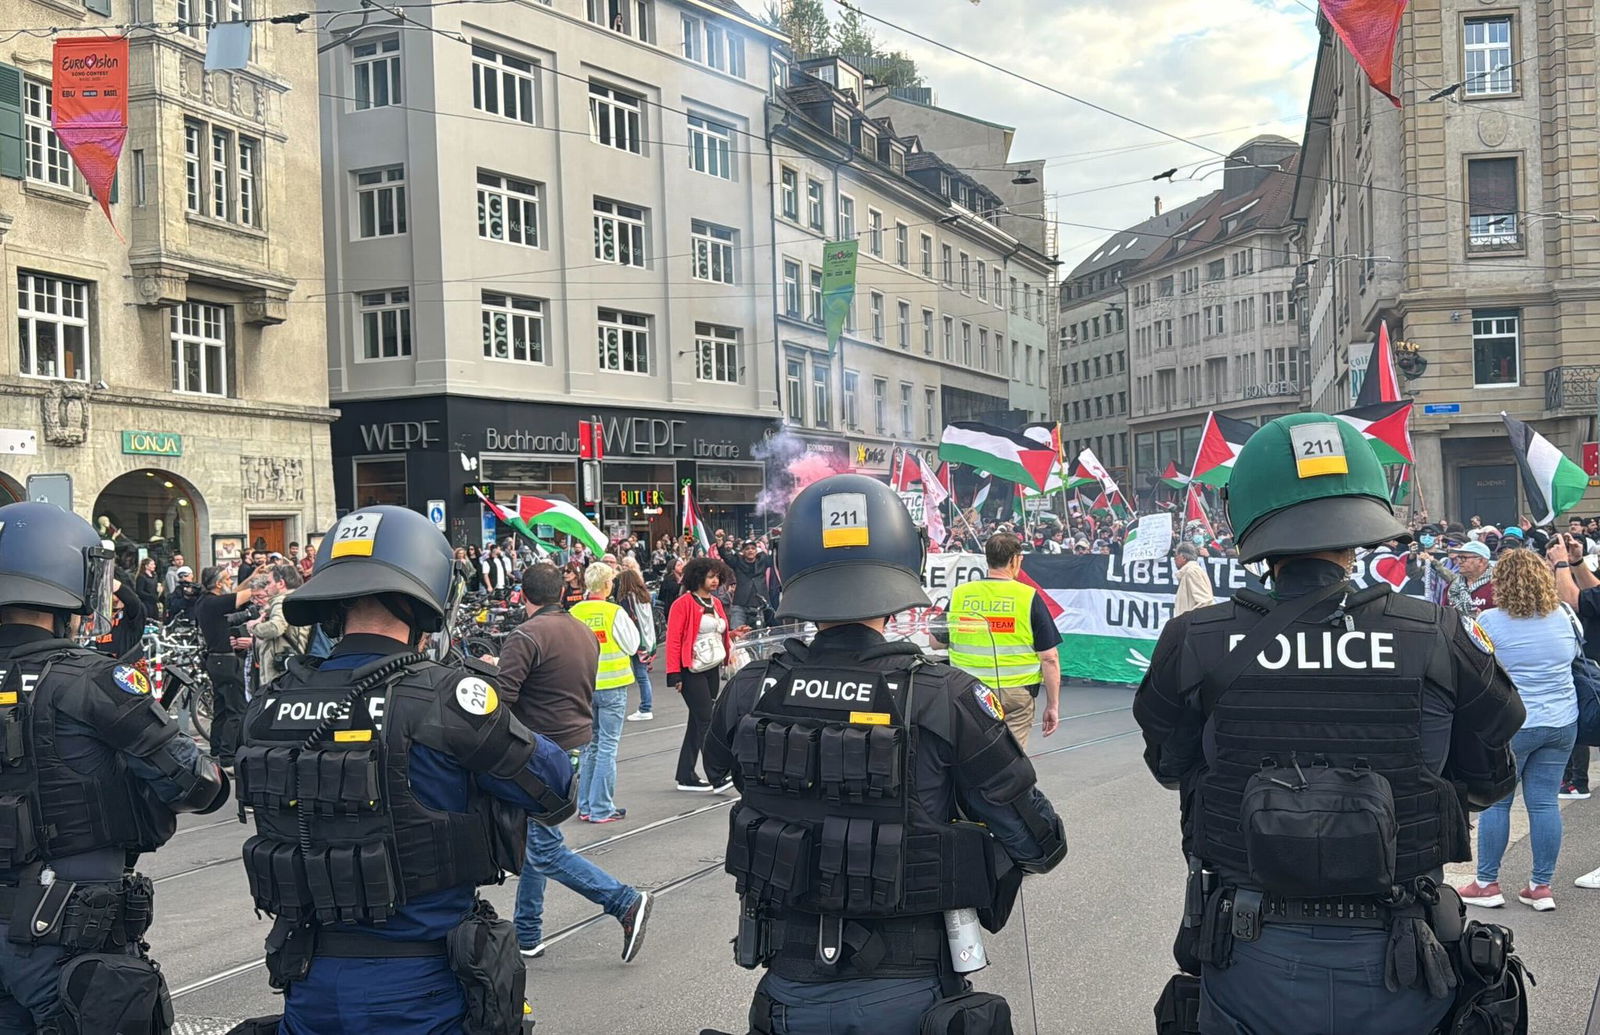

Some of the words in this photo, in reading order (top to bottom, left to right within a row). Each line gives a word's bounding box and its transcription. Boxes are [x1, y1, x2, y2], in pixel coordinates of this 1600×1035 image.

[360, 420, 440, 451] WEPF
[486, 428, 580, 452] Buchhandlu
[599, 416, 688, 455] WEPF
[1303, 439, 1333, 455] 211
[621, 490, 665, 505] BUTLERS
[830, 510, 858, 526] 211
[341, 526, 368, 539] 212
[1107, 553, 1247, 590] LIBETE
[962, 600, 1015, 613] POLIZEI
[991, 621, 1015, 630] TEAM
[471, 683, 487, 709] 212
[791, 679, 872, 702] POLICE
[277, 702, 352, 720] POLICE
